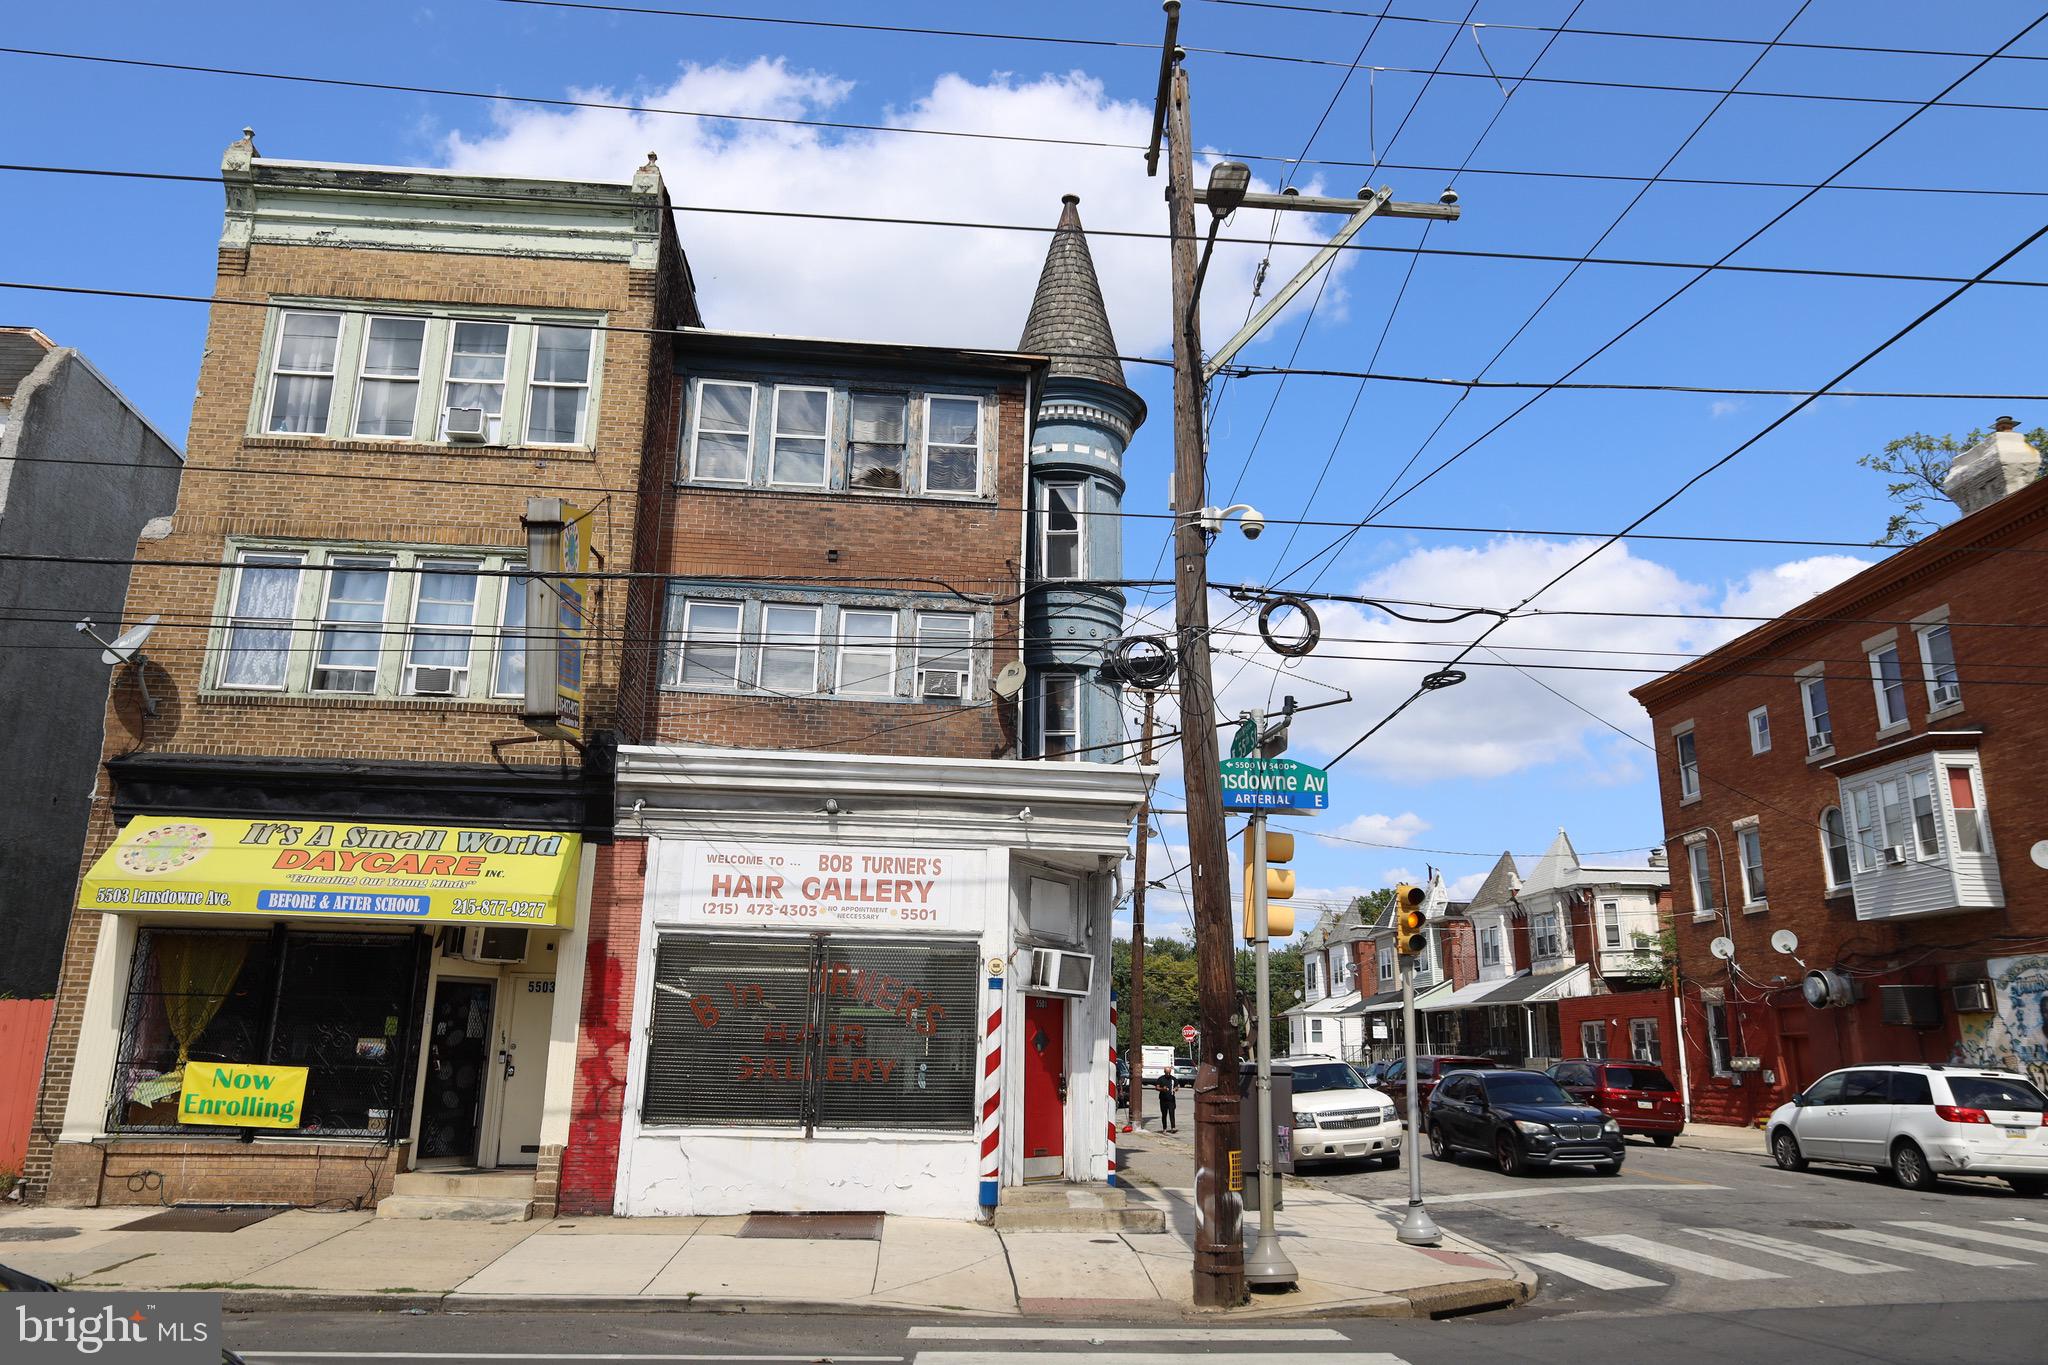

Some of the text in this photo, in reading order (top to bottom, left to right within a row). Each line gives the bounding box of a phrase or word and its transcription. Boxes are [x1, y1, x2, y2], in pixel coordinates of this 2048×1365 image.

[1235, 761, 1255, 770] 5500
[1257, 762, 1267, 770] W
[1220, 771, 1325, 791] nsdowne Av
[1235, 793, 1323, 807] ARTERIAL E
[240, 823, 562, 856] It's A Small World
[272, 849, 487, 876] DAYCARE
[707, 854, 763, 865] WELCOME
[818, 854, 942, 876] BOB TURNER'S
[484, 869, 506, 878] INC.
[387, 877, 428, 889] Young
[711, 874, 935, 903] HAIR GALLERY
[96, 888, 231, 905] 5503 Lansdowne Ave.
[268, 893, 420, 912] BEFORE & AFTER SCHOOL
[452, 899, 546, 918] 215-877-9277
[702, 902, 817, 917] (215) 473-4303
[837, 912, 880, 920] NECCESSARY
[841, 906, 888, 914] APPOINTMENT
[900, 908, 937, 921] 5501
[528, 981, 555, 993] 5503
[212, 1068, 276, 1090] Now
[184, 1093, 295, 1123] Enrolling
